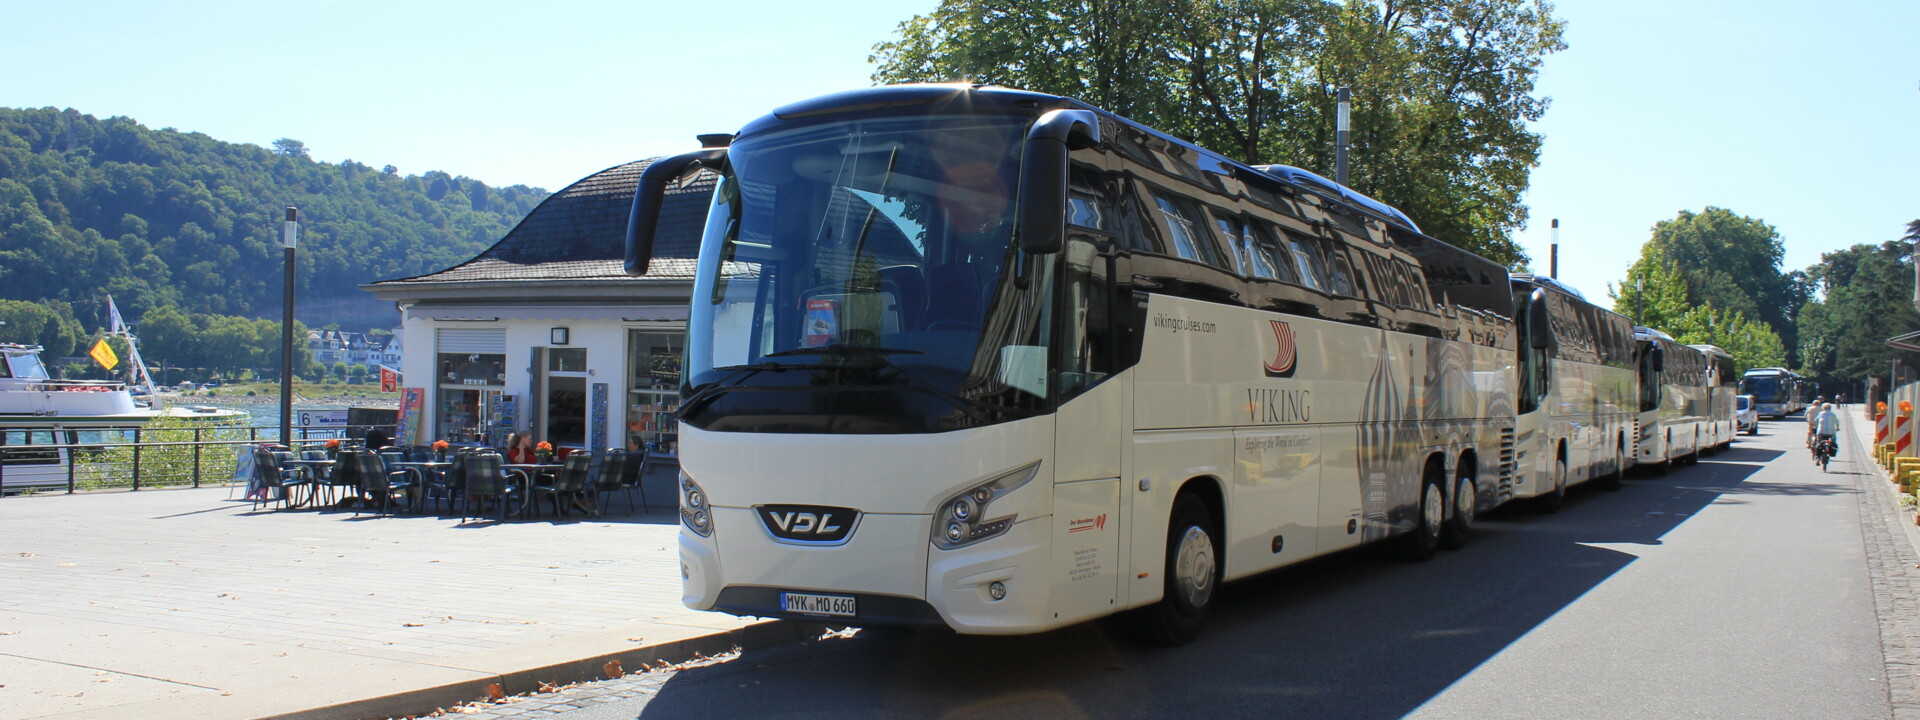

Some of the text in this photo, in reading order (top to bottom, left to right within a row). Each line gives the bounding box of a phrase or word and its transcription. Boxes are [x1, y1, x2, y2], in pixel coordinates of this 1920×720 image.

[1153, 313, 1216, 334] vikingcruises.com
[1247, 388, 1311, 423] VIKING
[302, 412, 311, 426] 6
[769, 511, 841, 534] VDL
[786, 594, 855, 614] MYK MO 660
